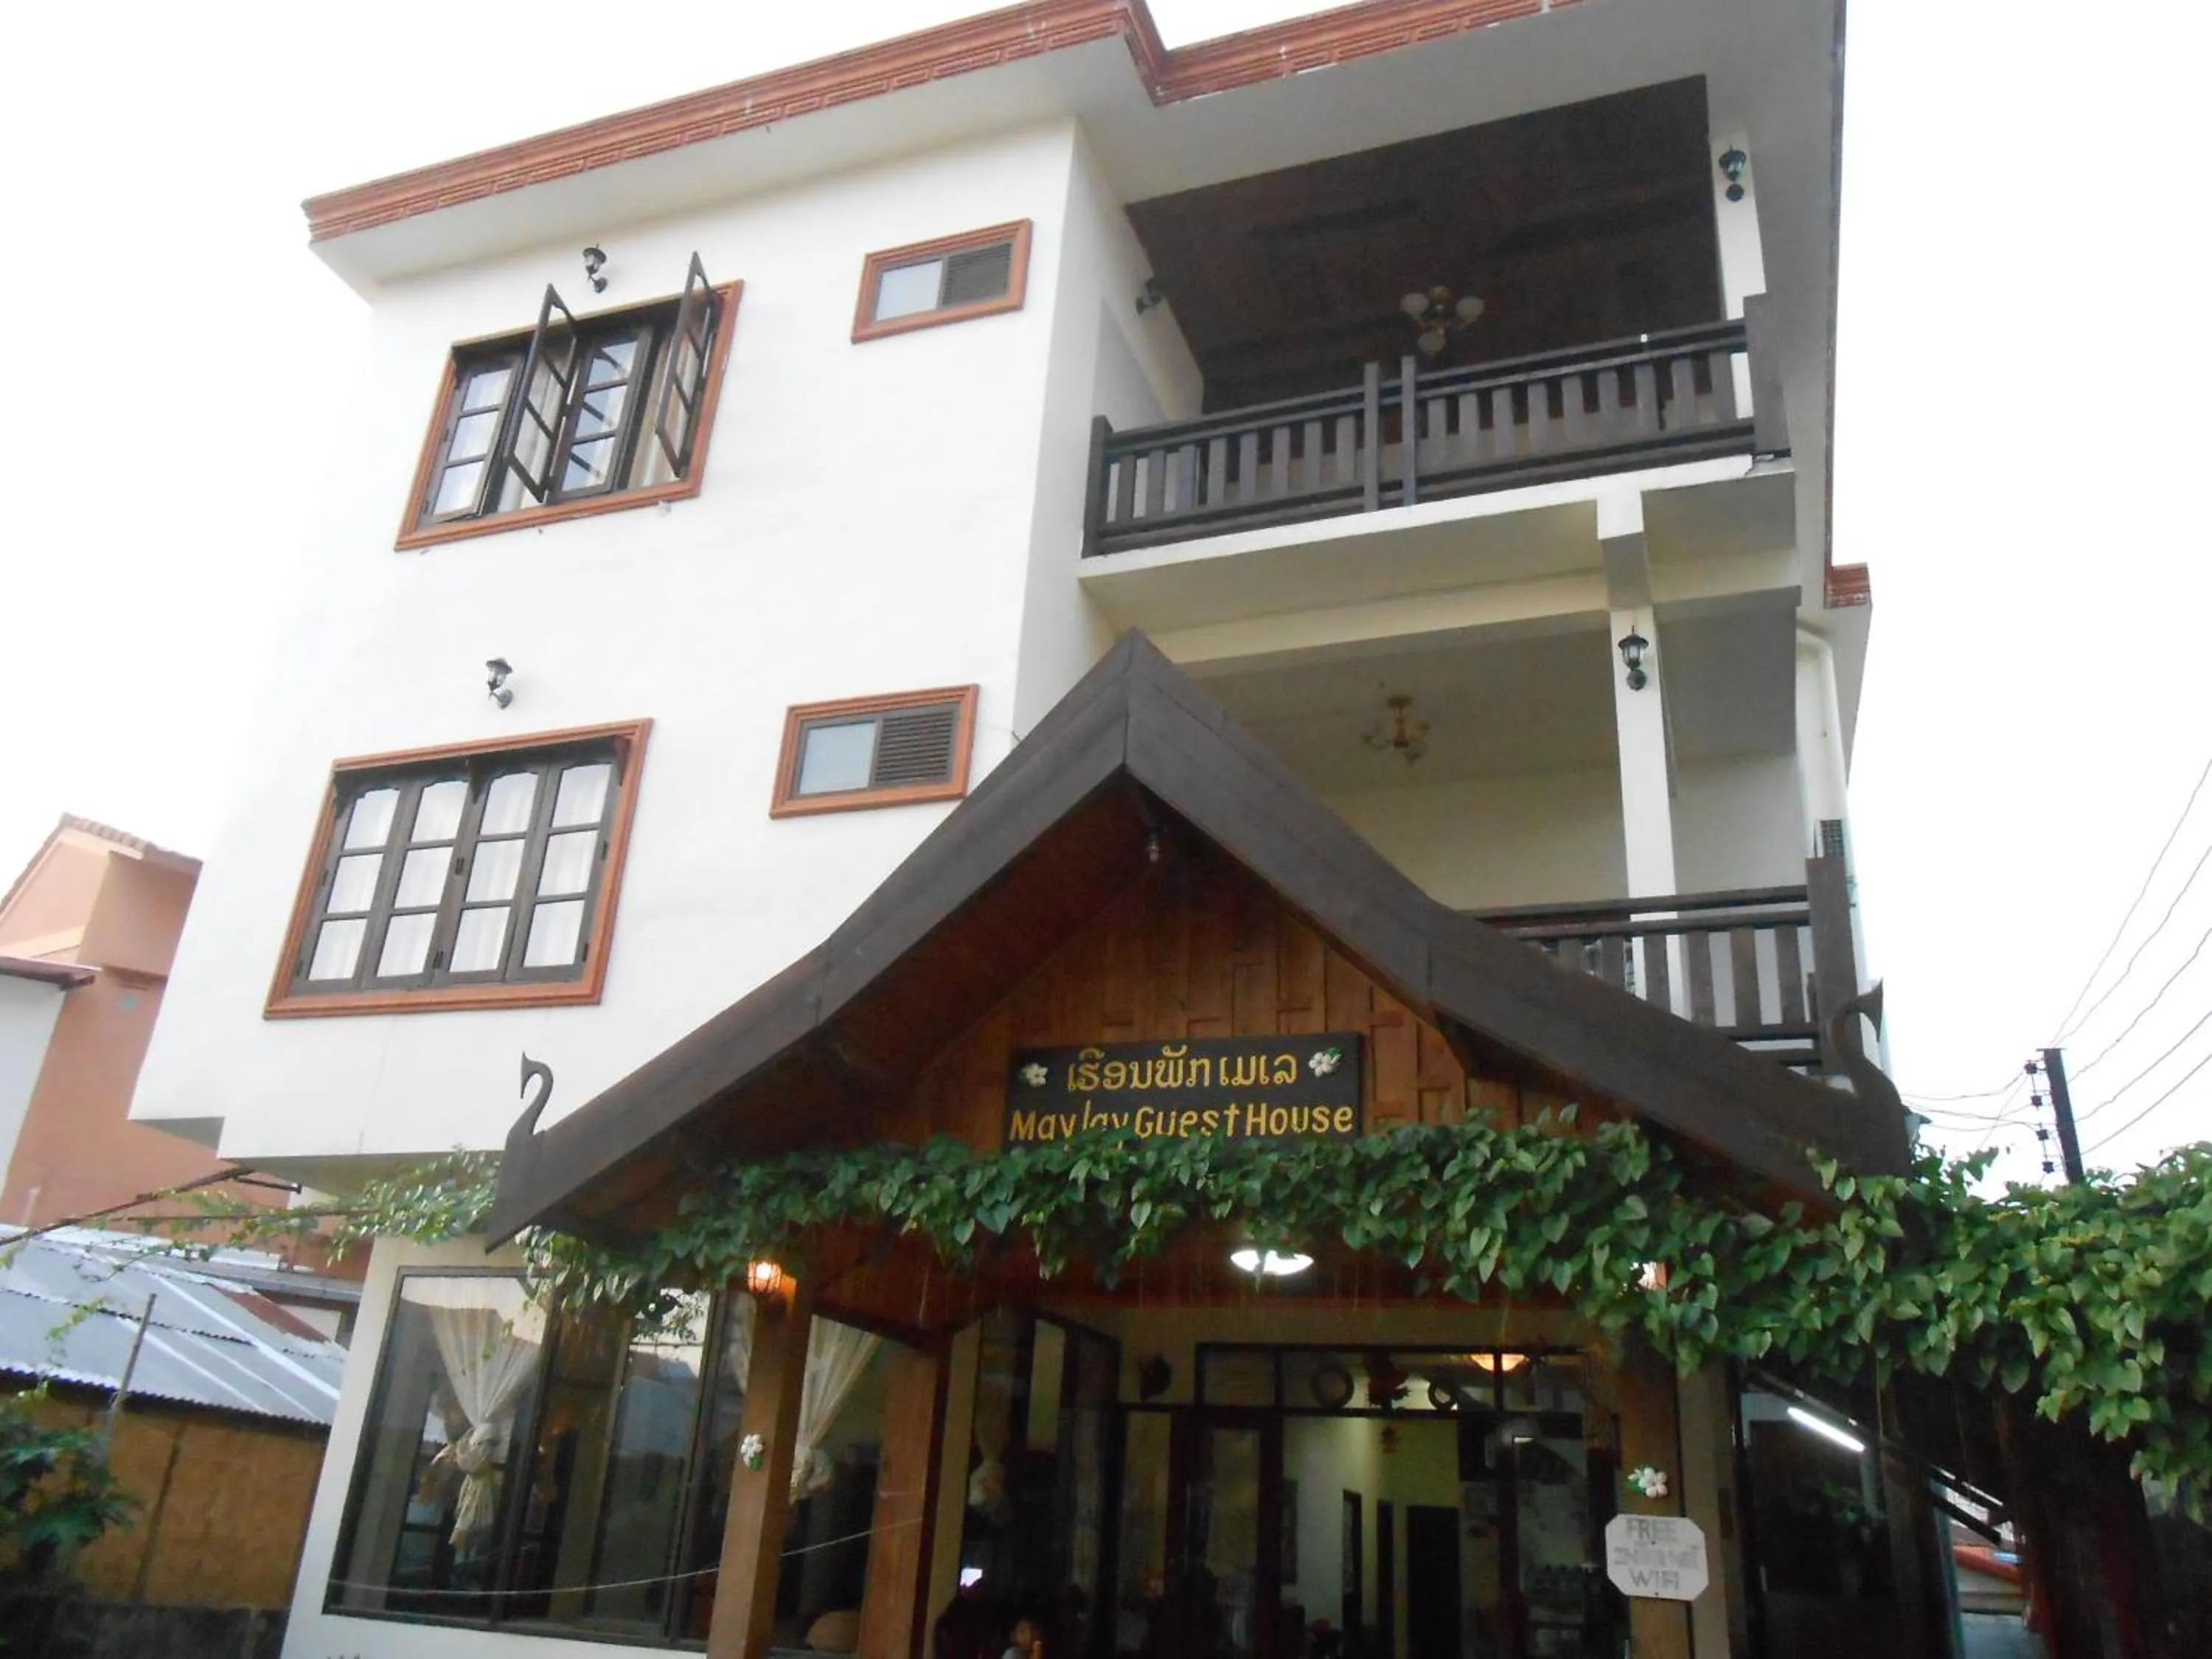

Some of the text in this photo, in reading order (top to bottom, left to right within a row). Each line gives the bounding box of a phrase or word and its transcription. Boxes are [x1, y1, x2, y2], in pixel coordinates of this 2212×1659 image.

[1134, 1103, 1241, 1138] Guest
[1245, 1103, 1354, 1137] House
[1625, 1517, 1678, 1543] FREE
[1613, 1545, 1700, 1570] INNET
[1628, 1568, 1680, 1590] WIFI
